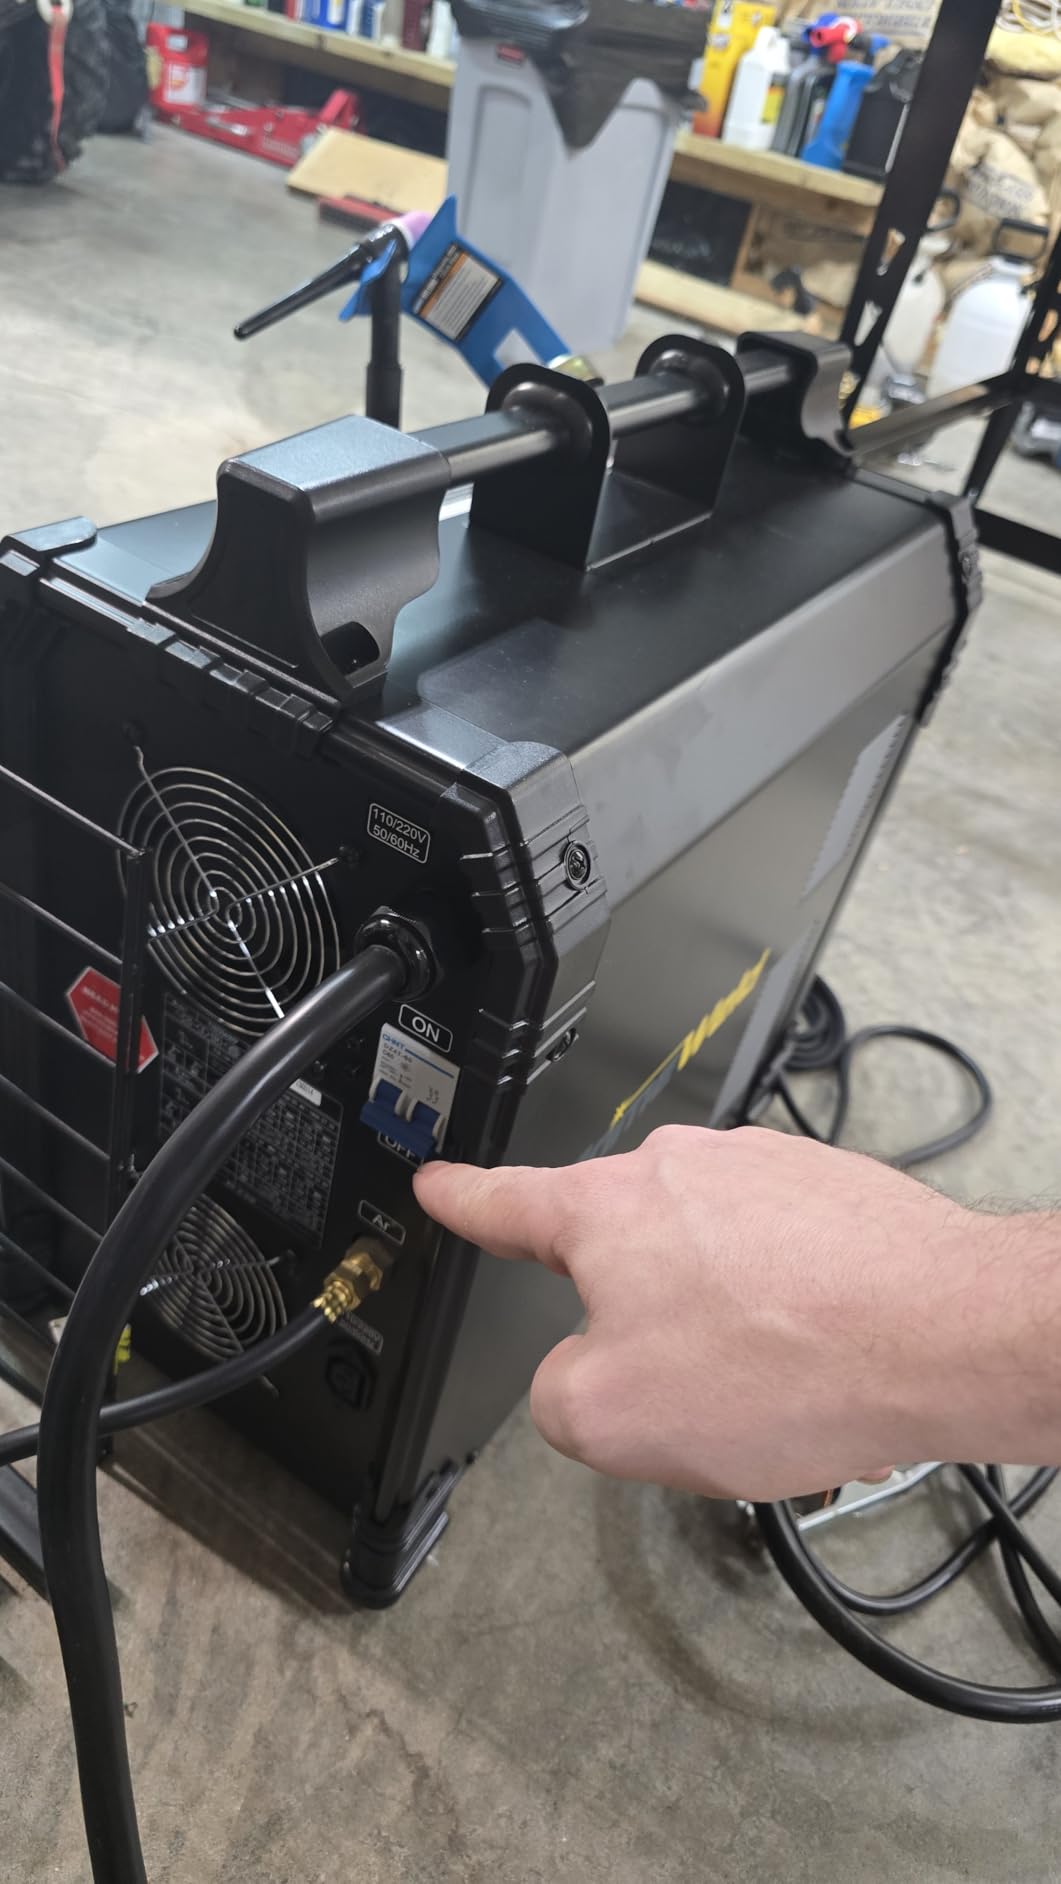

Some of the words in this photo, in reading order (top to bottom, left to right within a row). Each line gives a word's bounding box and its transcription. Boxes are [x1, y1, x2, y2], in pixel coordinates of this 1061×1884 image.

[373, 808, 427, 843] 110/220V
[373, 824, 420, 858] 50/60Hz
[412, 1016, 440, 1042] ON
[372, 1214, 391, 1231] Ar
